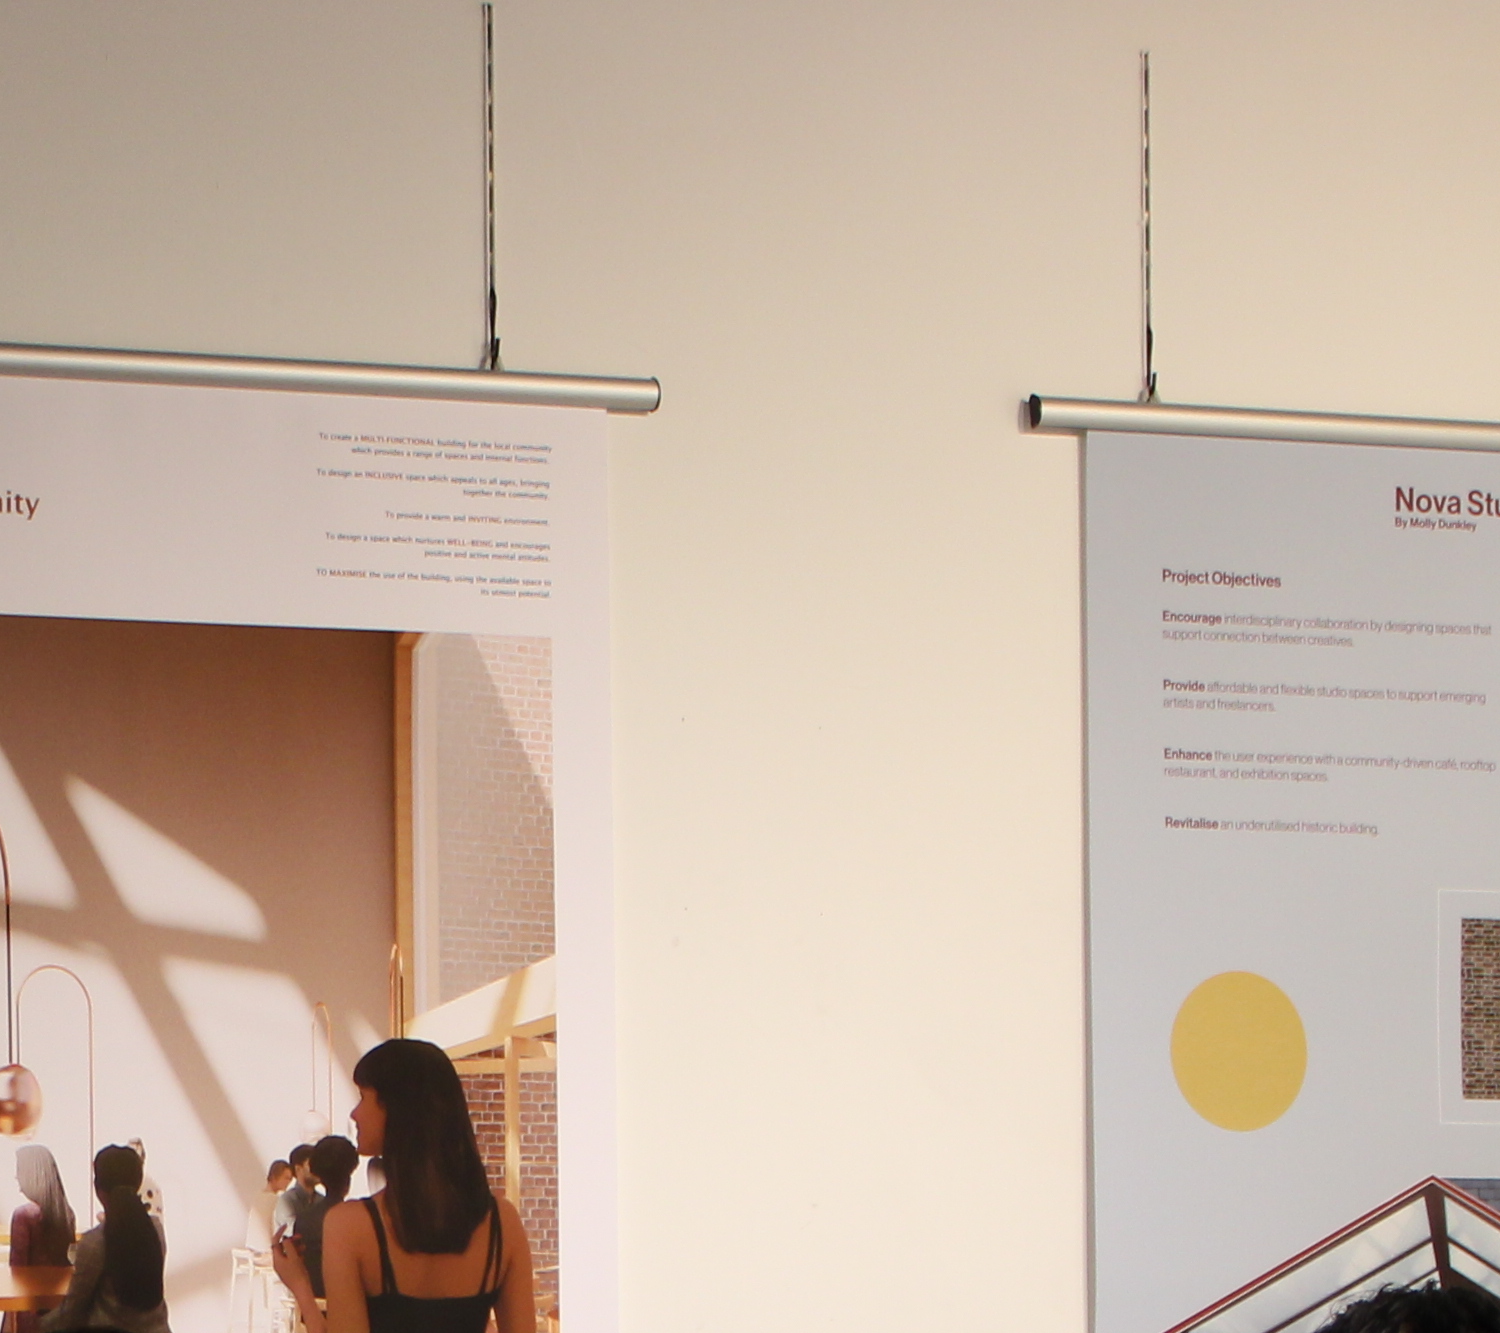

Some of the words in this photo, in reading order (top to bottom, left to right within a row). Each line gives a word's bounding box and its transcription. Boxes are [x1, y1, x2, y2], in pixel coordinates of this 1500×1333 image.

[1395, 486, 1462, 515] Nova
[1162, 568, 1210, 587] Project
[1211, 571, 1281, 589] Objectives
[1162, 610, 1222, 627] Encourage
[1163, 679, 1206, 692] Provide
[1164, 748, 1213, 761] Enhance
[1165, 816, 1219, 830] Revitalise
